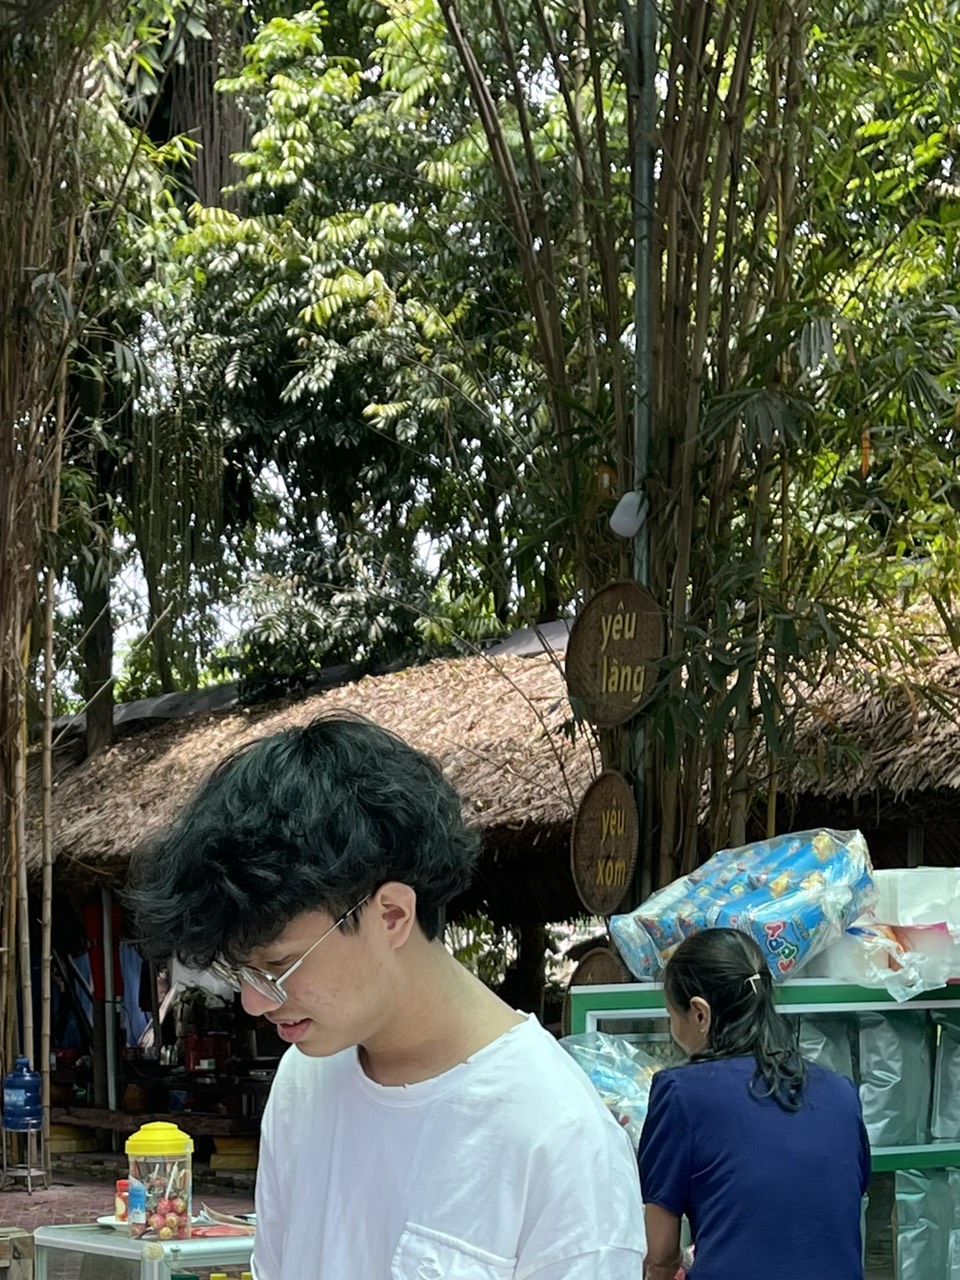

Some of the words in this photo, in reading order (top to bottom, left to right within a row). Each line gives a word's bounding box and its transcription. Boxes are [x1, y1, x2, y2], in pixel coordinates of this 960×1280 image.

[601, 600, 637, 652] yêu
[601, 655, 646, 703] làng
[601, 797, 626, 846] yêu
[596, 848, 626, 887] xóm
